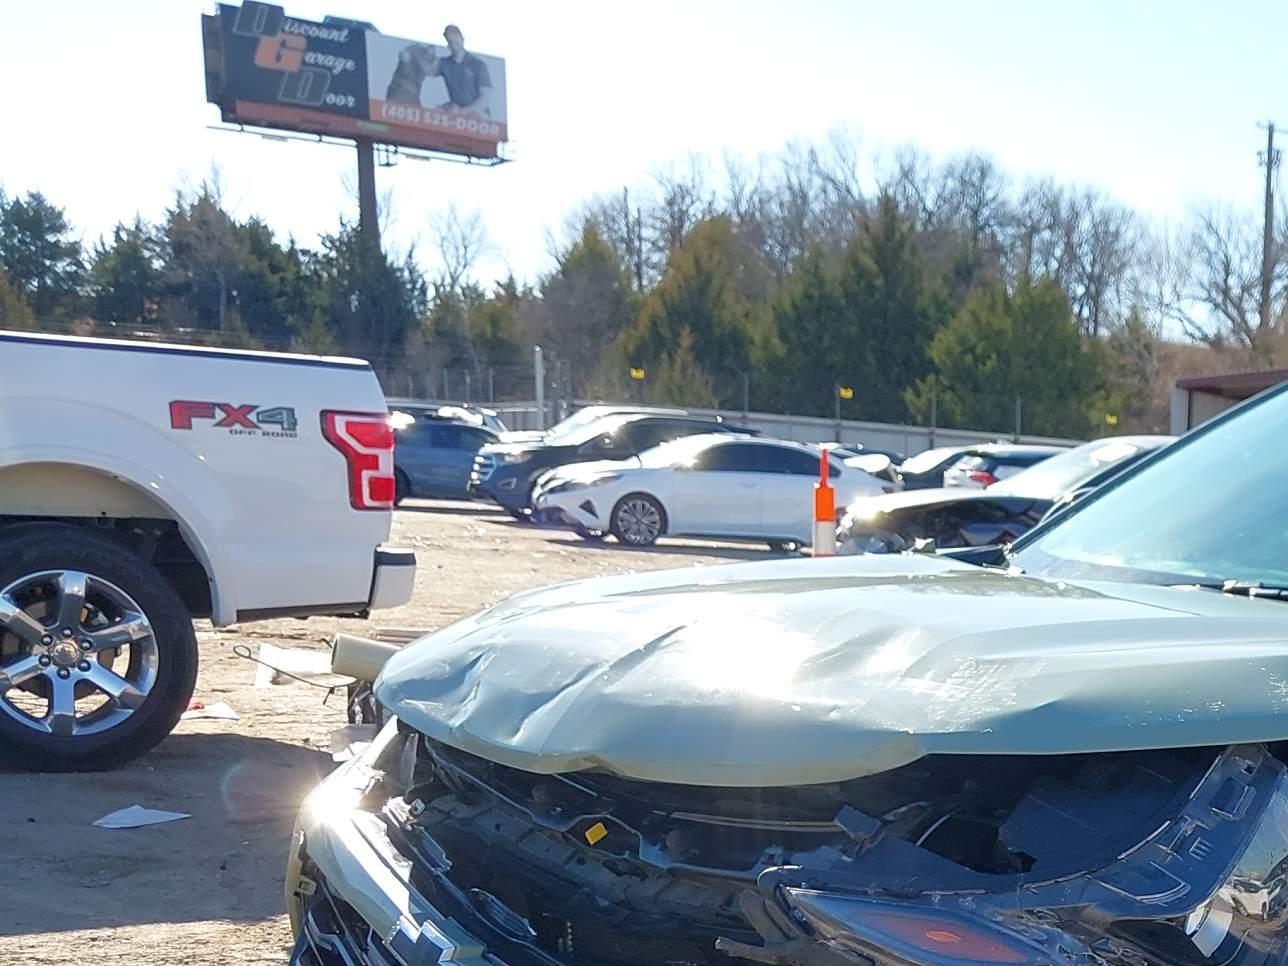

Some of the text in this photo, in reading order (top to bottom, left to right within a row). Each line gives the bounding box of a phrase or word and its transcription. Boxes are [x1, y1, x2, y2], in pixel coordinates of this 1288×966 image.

[254, 33, 356, 75] Garage
[277, 64, 356, 108] Door
[168, 400, 298, 431] FX4
